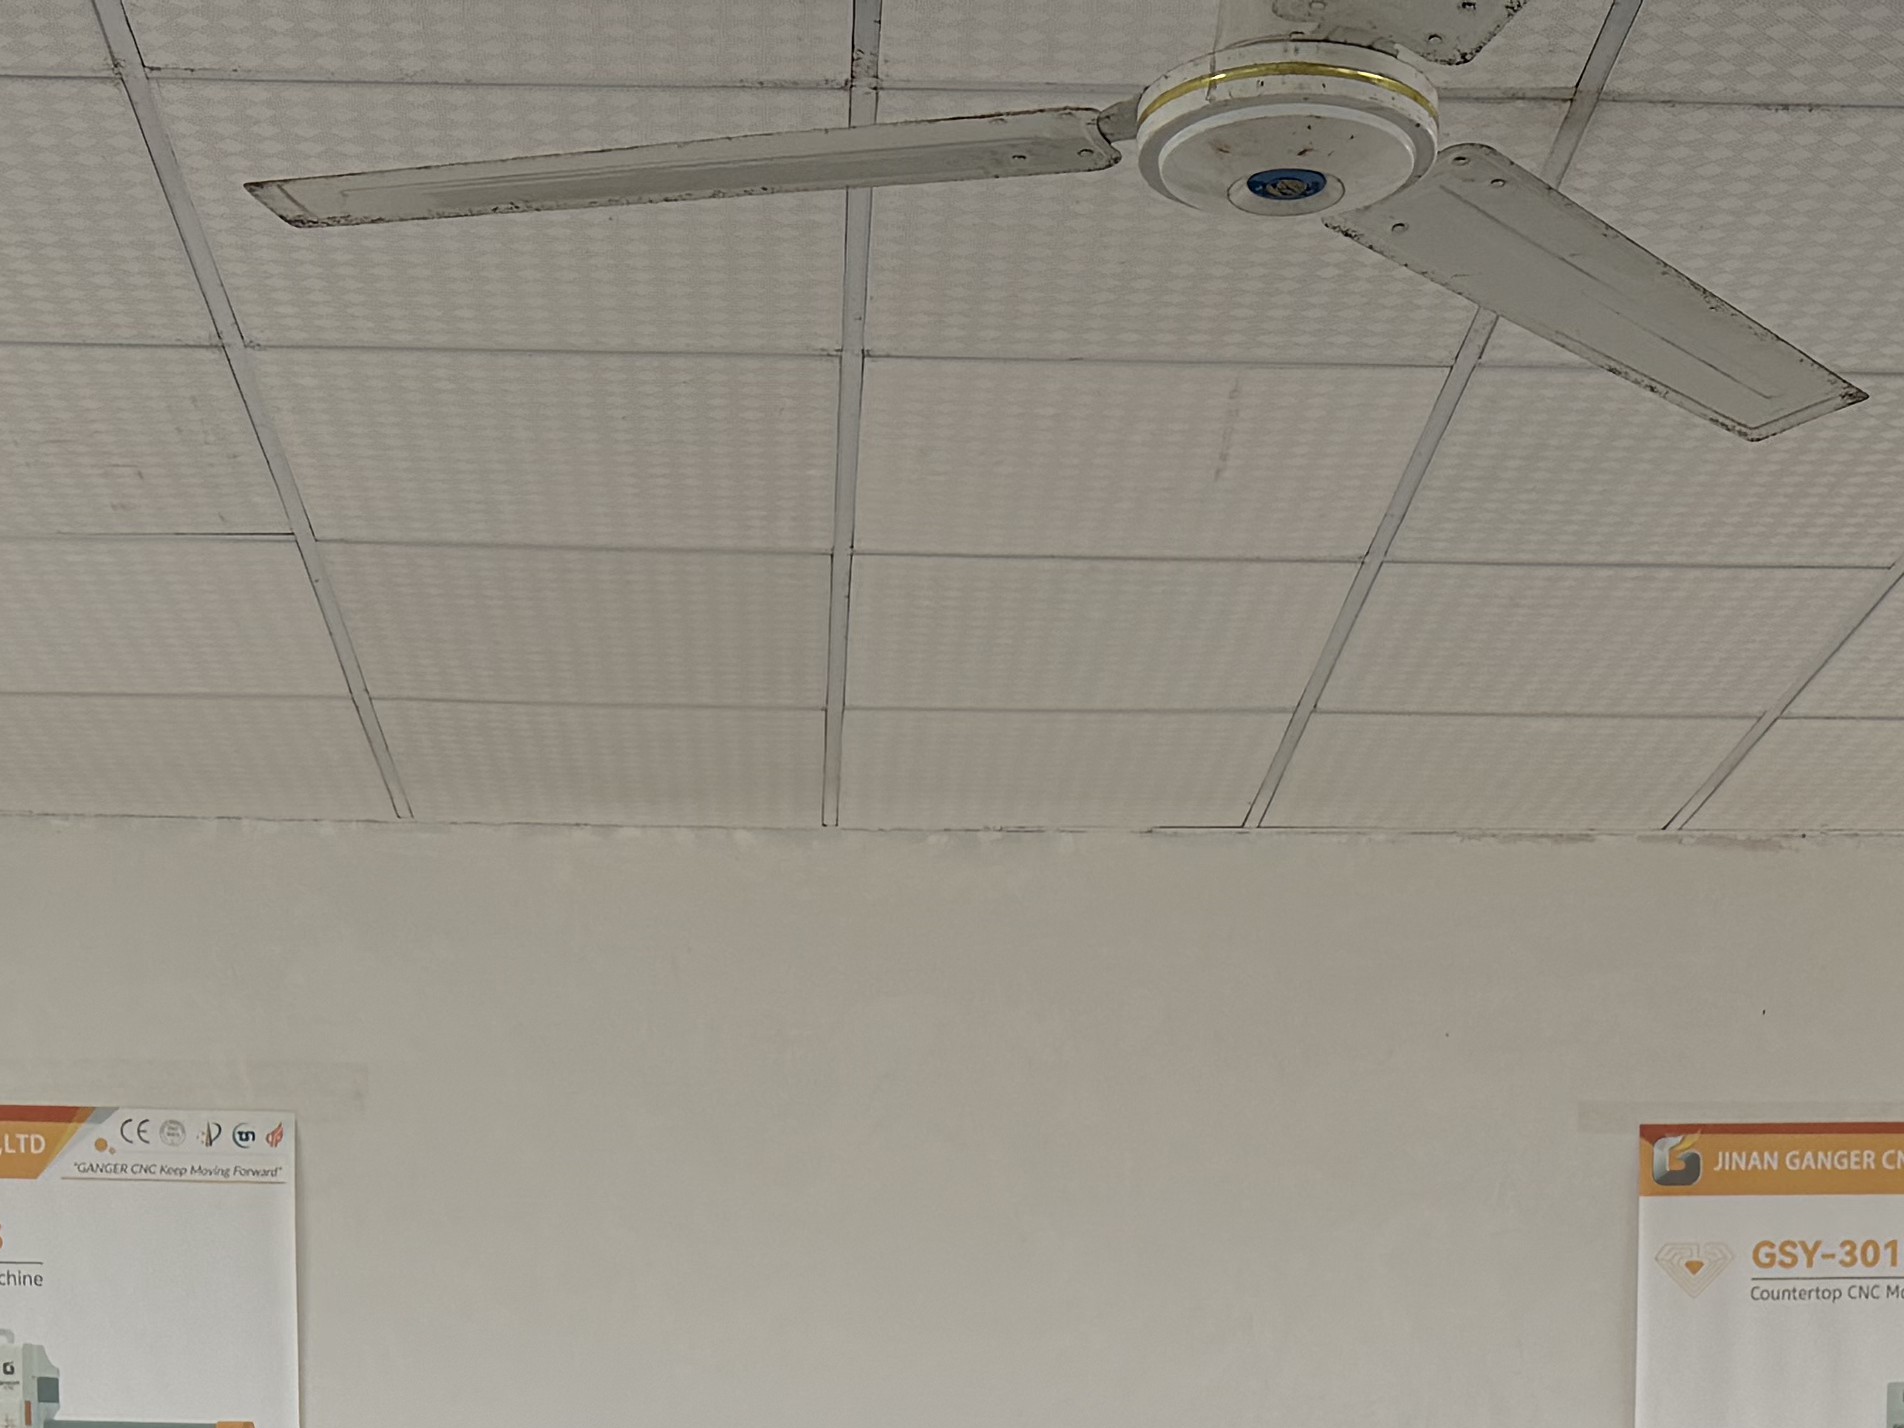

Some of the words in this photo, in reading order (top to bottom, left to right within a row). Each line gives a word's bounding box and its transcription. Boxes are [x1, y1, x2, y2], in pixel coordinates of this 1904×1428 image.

[131, 1163, 157, 1175] CNC
[1713, 1149, 1780, 1172] JINAN
[1785, 1149, 1876, 1171] GANGER
[1750, 1284, 1843, 1304] Countertop
[1847, 1283, 1881, 1301] CNC
